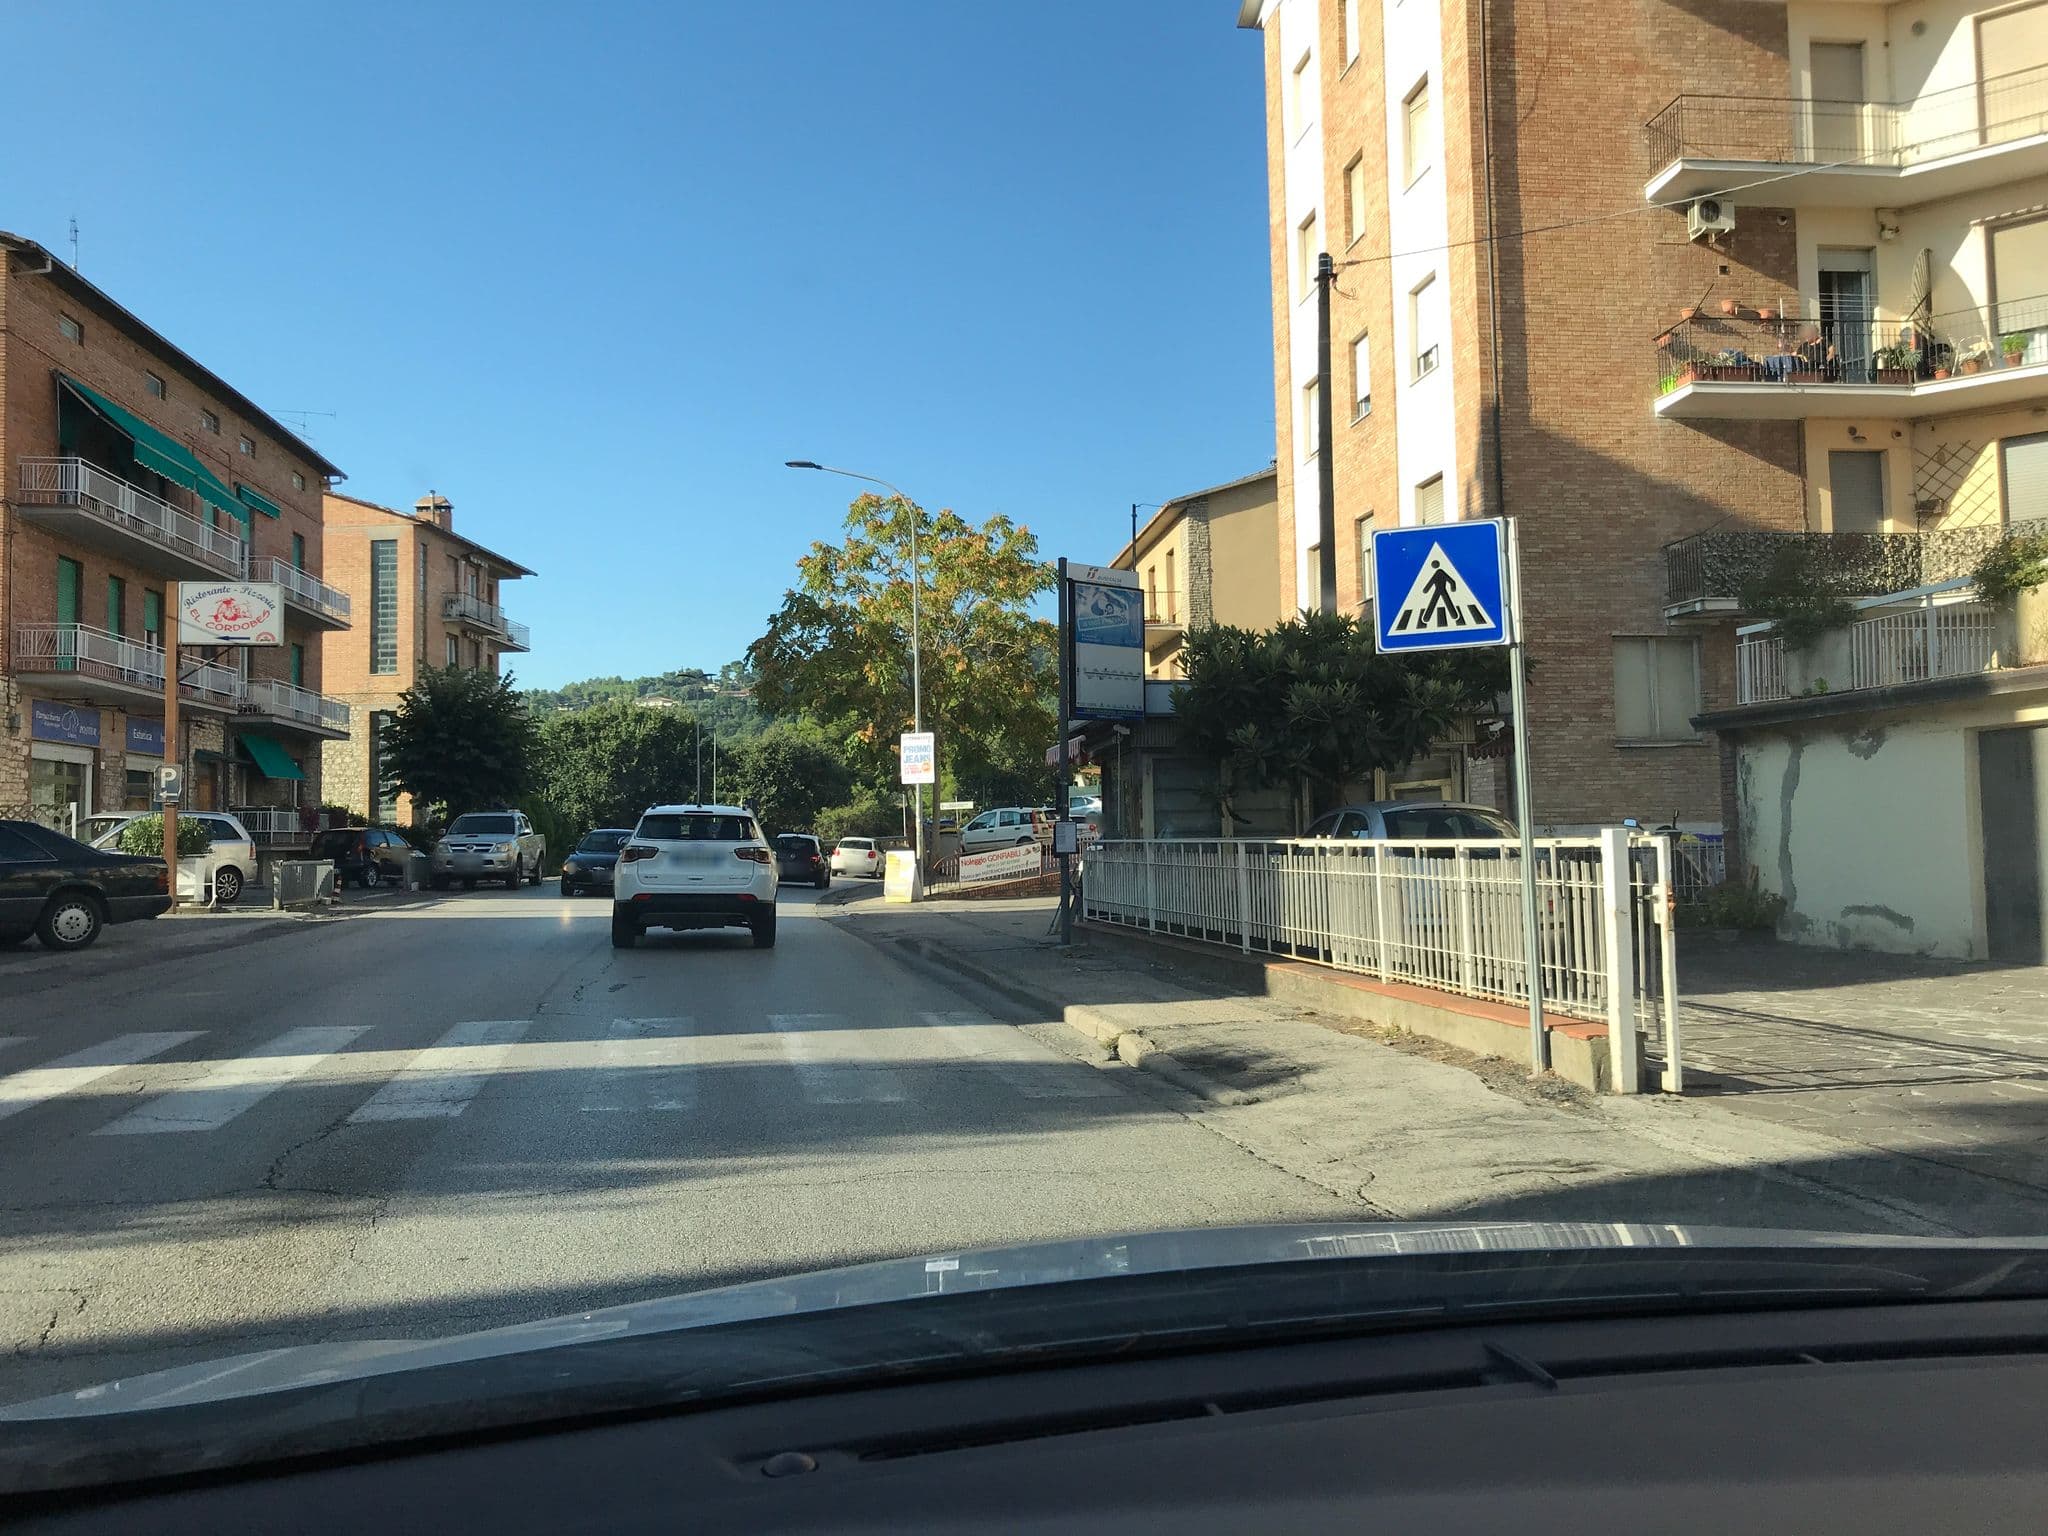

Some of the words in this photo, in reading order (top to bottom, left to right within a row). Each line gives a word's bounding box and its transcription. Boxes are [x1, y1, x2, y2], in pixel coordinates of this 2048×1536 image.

[184, 585, 231, 609] Ristorante
[241, 586, 276, 610] Pizzeria
[190, 608, 201, 623] EL
[205, 609, 271, 632] CORDOBES
[133, 728, 153, 741] Estetica
[903, 744, 932, 753] PROMO
[903, 754, 932, 764] JEANS
[160, 767, 177, 788] P
[961, 855, 987, 868] Noleggio
[987, 849, 1021, 862] GONFIABILI
